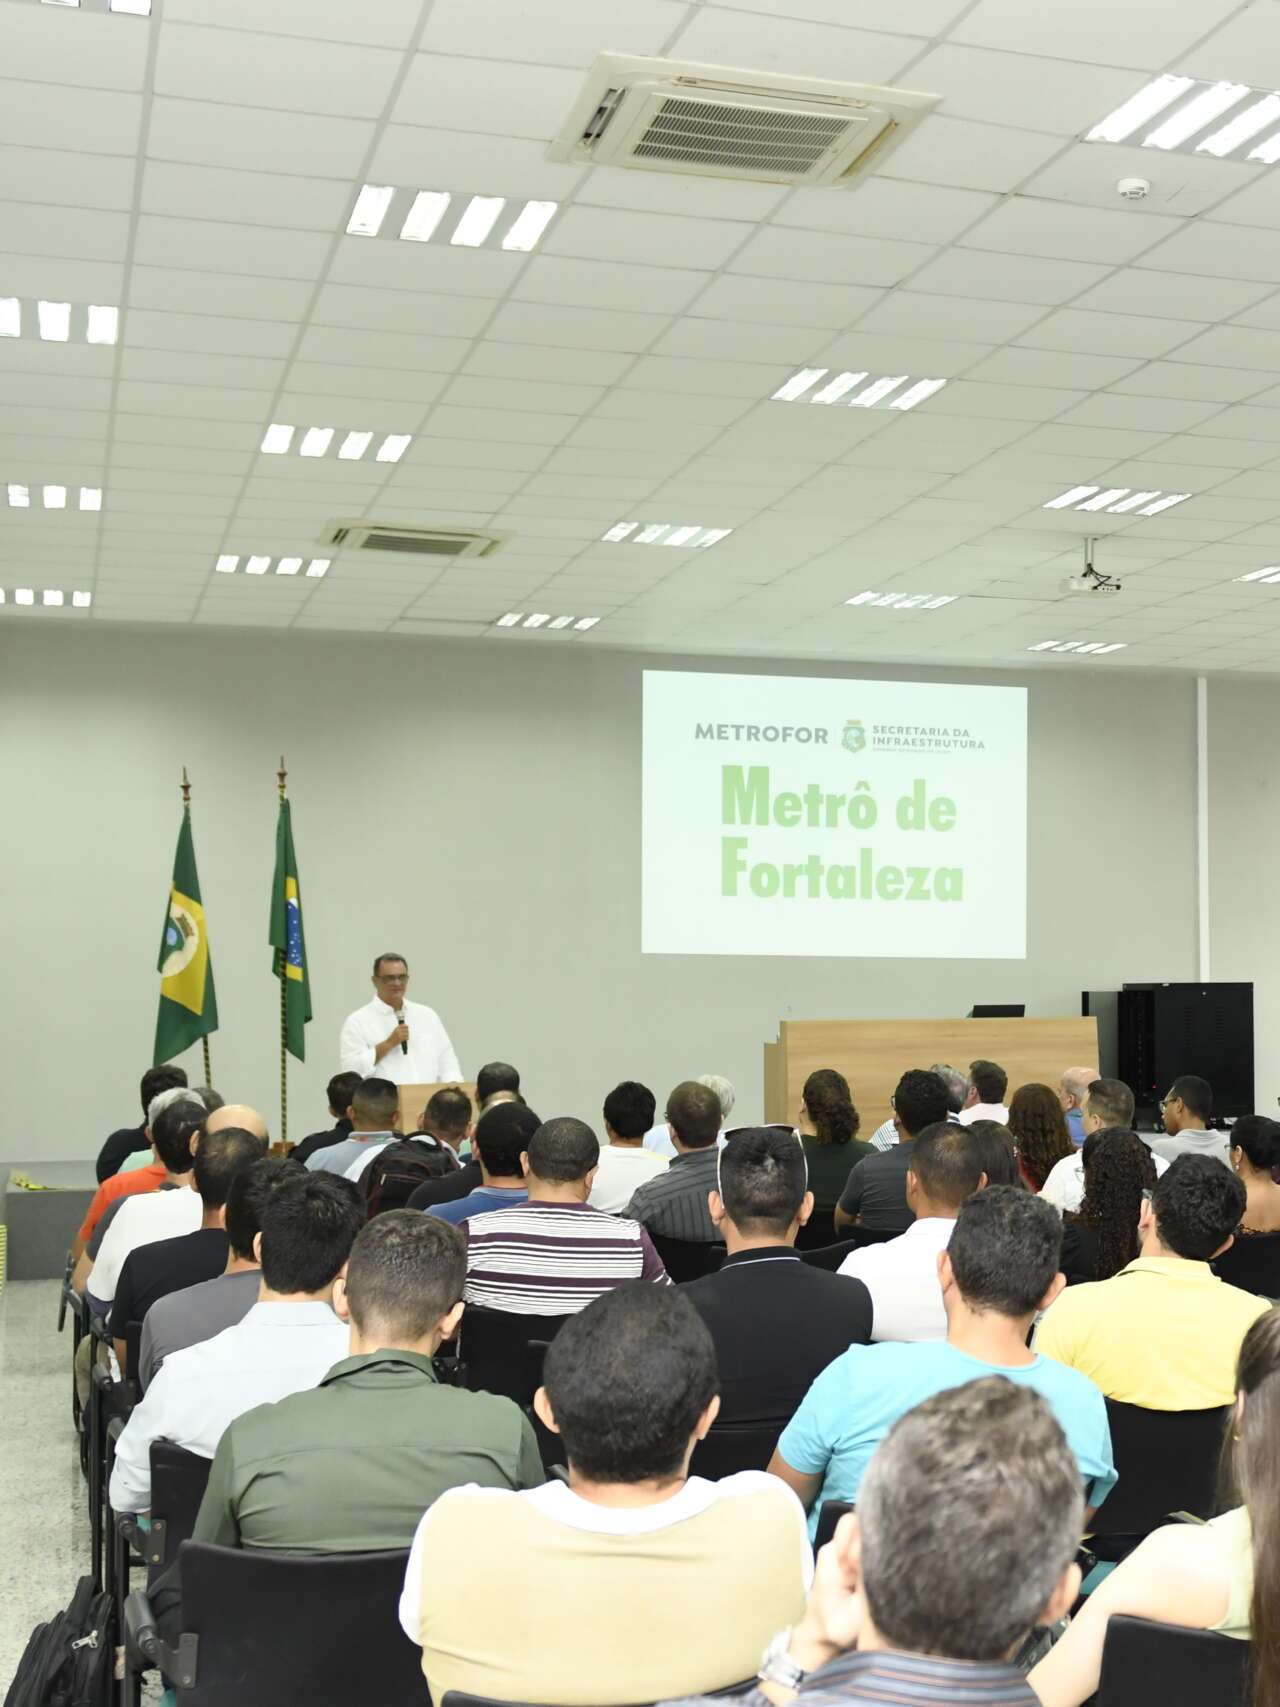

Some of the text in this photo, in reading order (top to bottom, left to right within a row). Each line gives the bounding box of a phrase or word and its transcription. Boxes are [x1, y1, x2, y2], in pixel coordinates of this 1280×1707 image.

[694, 723, 829, 745] METROFOR
[872, 725, 970, 738] SECRETARIA DA
[872, 736, 986, 750] INFRAESTRUTURA
[721, 765, 957, 832] Metrô de
[721, 836, 963, 902] Fortaleza
